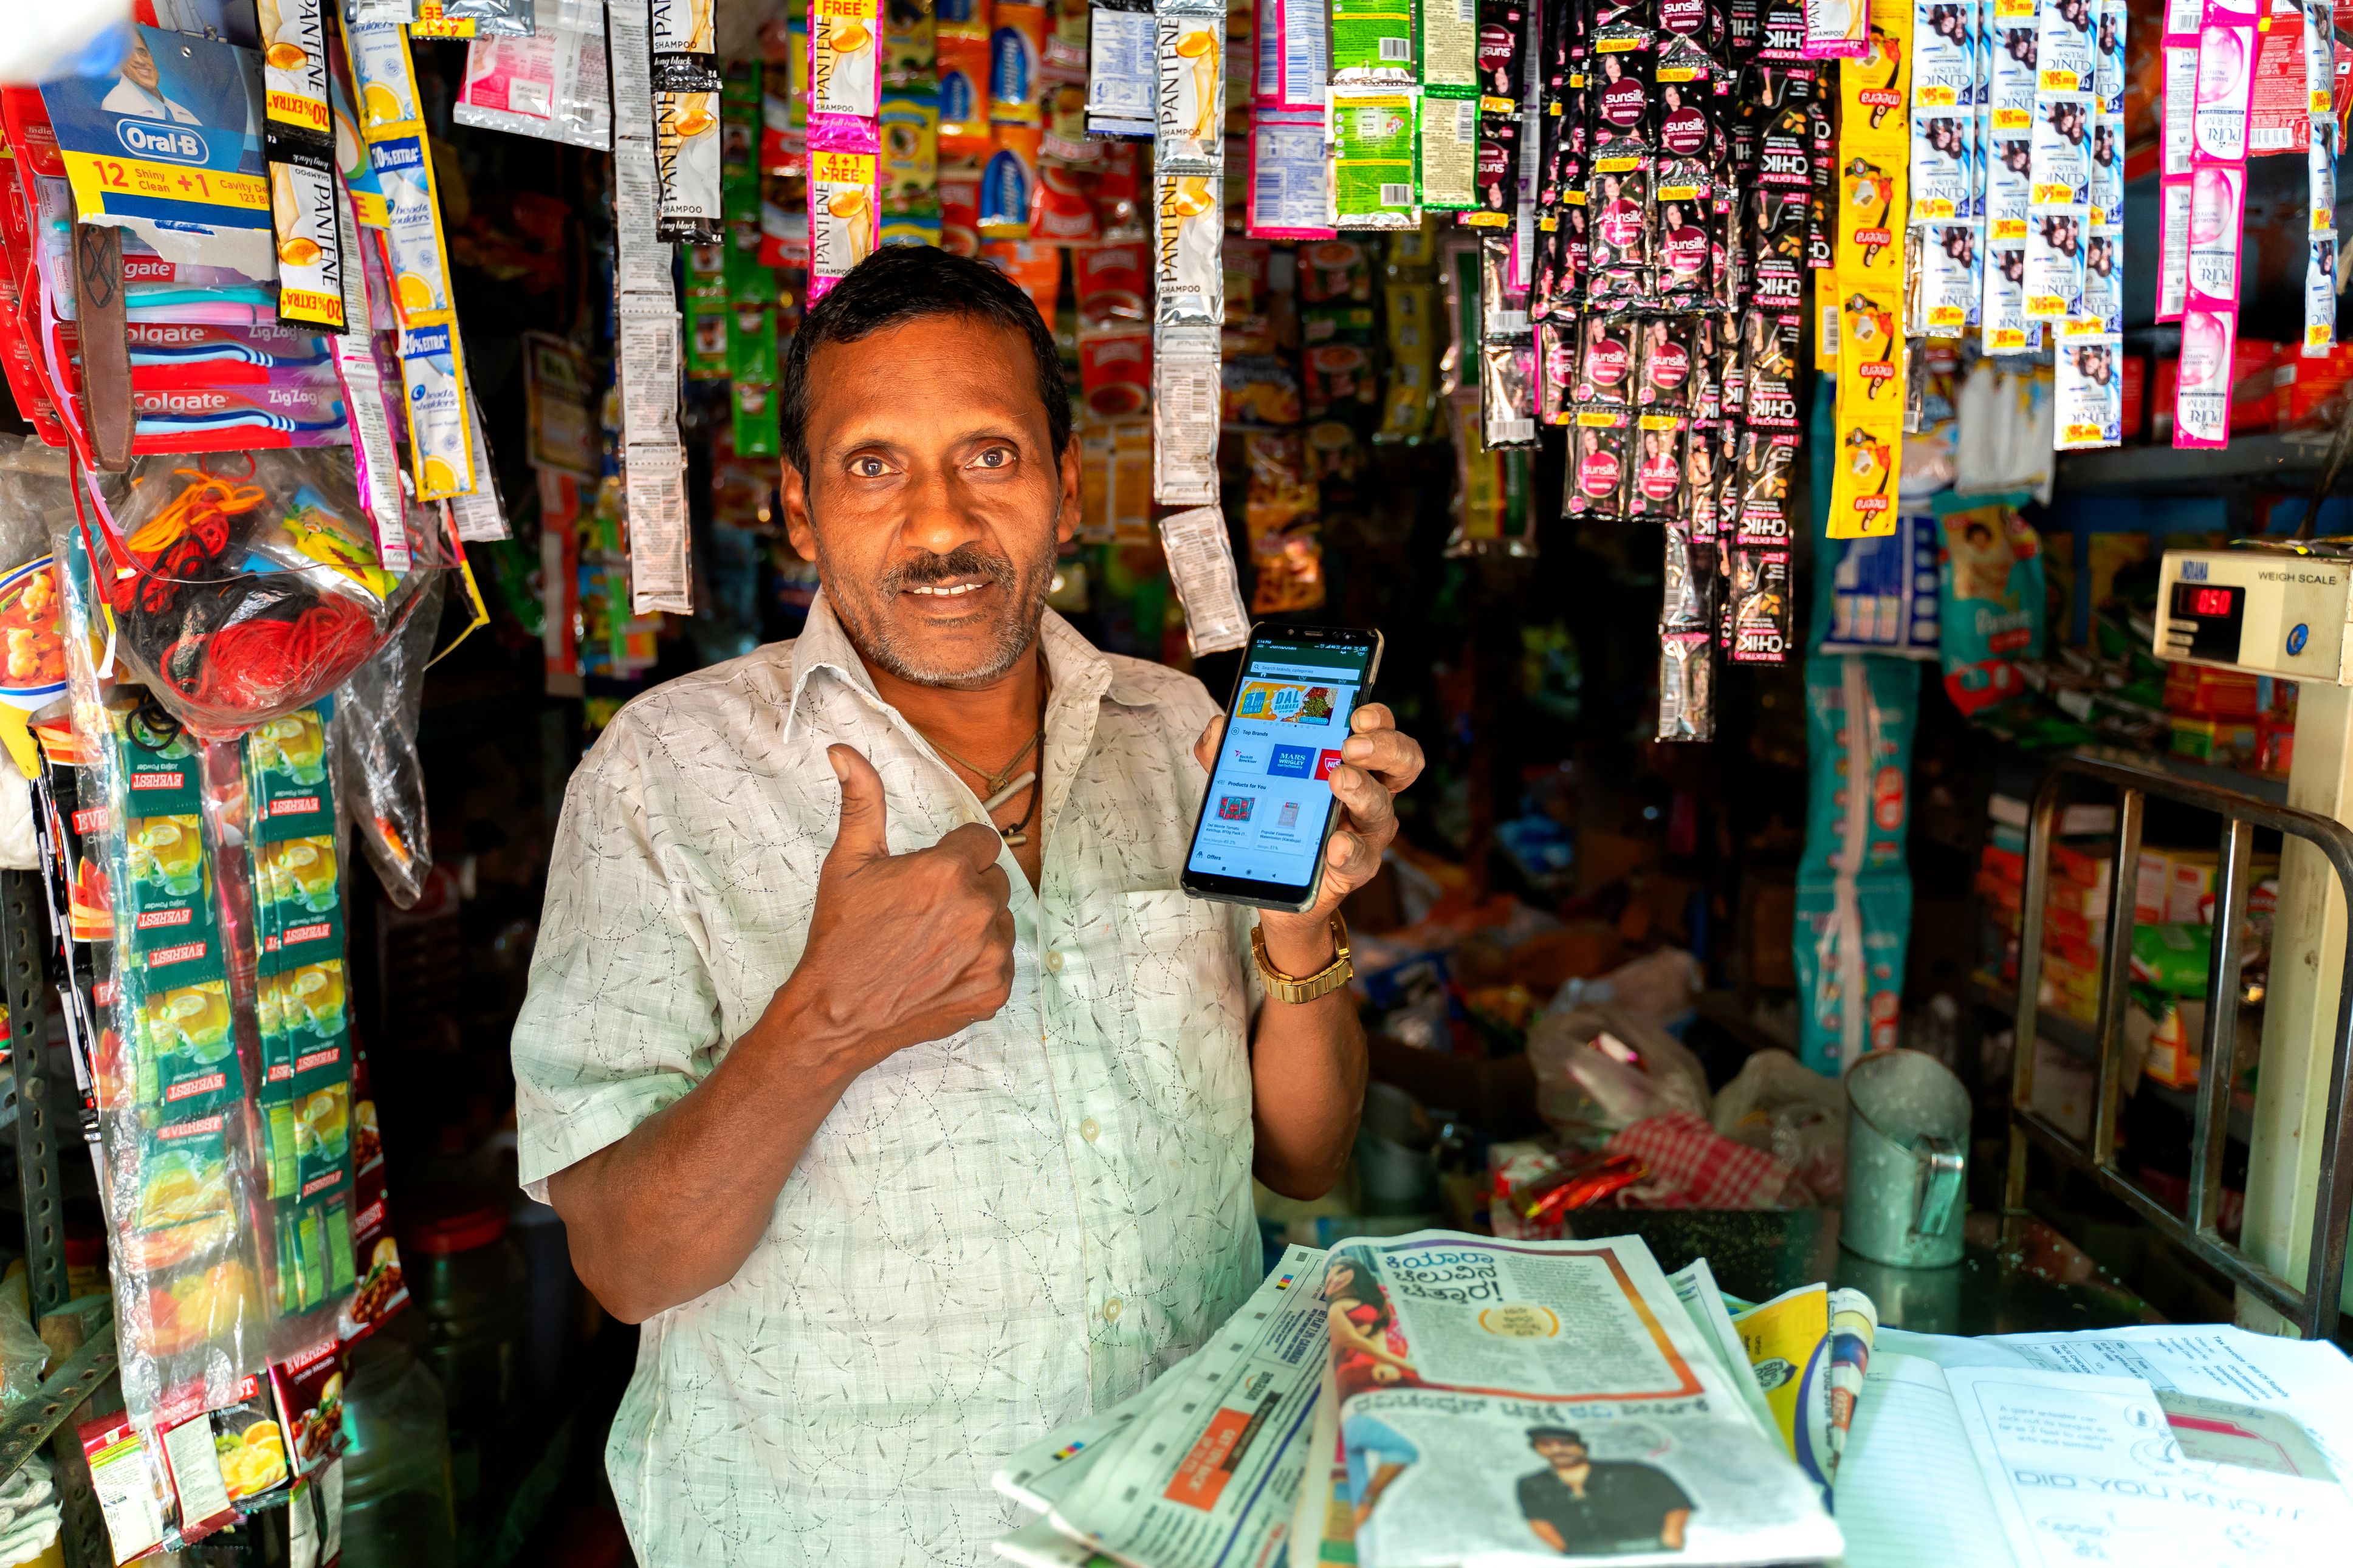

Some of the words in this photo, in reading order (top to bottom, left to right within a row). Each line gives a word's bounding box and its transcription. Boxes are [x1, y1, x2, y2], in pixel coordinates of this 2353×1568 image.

[654, 41, 697, 50] SHAMPOO
[816, 15, 832, 101] PANTENE
[1161, 16, 1180, 126] PANTENE
[1860, 91, 1901, 106] meera
[816, 103, 854, 113] SHAMPOO
[2204, 115, 2242, 127] DERM
[1160, 128, 1201, 137] SHAMPOO
[2205, 128, 2242, 142] PURE
[126, 127, 199, 156] Oral-B
[828, 154, 837, 168] 4
[1760, 154, 1809, 175] CHIK
[92, 160, 129, 188] 12
[135, 168, 165, 182] Shiny
[295, 168, 330, 182] SHAMPOO
[139, 180, 171, 193] Clean
[220, 179, 251, 193] Cavity
[239, 193, 256, 204] 123
[815, 182, 830, 265] PANTENE
[1160, 176, 1179, 283] PANTENE
[313, 183, 338, 290] PANTENE
[2197, 257, 2235, 268] DERM
[816, 267, 850, 276] SHAMPO
[2199, 268, 2233, 281] PURE
[1160, 285, 1201, 294] SHAMPOO
[1756, 278, 1801, 298] CHIK
[249, 324, 300, 341] ZigZag
[268, 388, 319, 406] ZigZag
[2186, 408, 2223, 423] PURE
[1740, 518, 1787, 537] CHIK
[2258, 570, 2295, 581] WEIGH
[2298, 573, 2337, 585] SCALE
[1739, 634, 1784, 653] CHIK
[1276, 691, 1299, 705] DAL
[1274, 702, 1299, 711] DHAMAKA
[133, 773, 184, 789] EVEREST
[271, 797, 320, 815] EVEREST
[140, 908, 190, 928] EVEREST
[152, 943, 204, 966] EVEREST
[168, 1073, 224, 1100] EVEREST
[2070, 1354, 2092, 1374] CHICKEN
[2213, 1335, 2225, 1346] Tax
[2223, 1346, 2246, 1363] Invoice
[2266, 1380, 2290, 1398] Supply
[1245, 1371, 1275, 1401] amazon
[2014, 1469, 2077, 1489] DID
[2089, 1476, 2170, 1499] YOU
